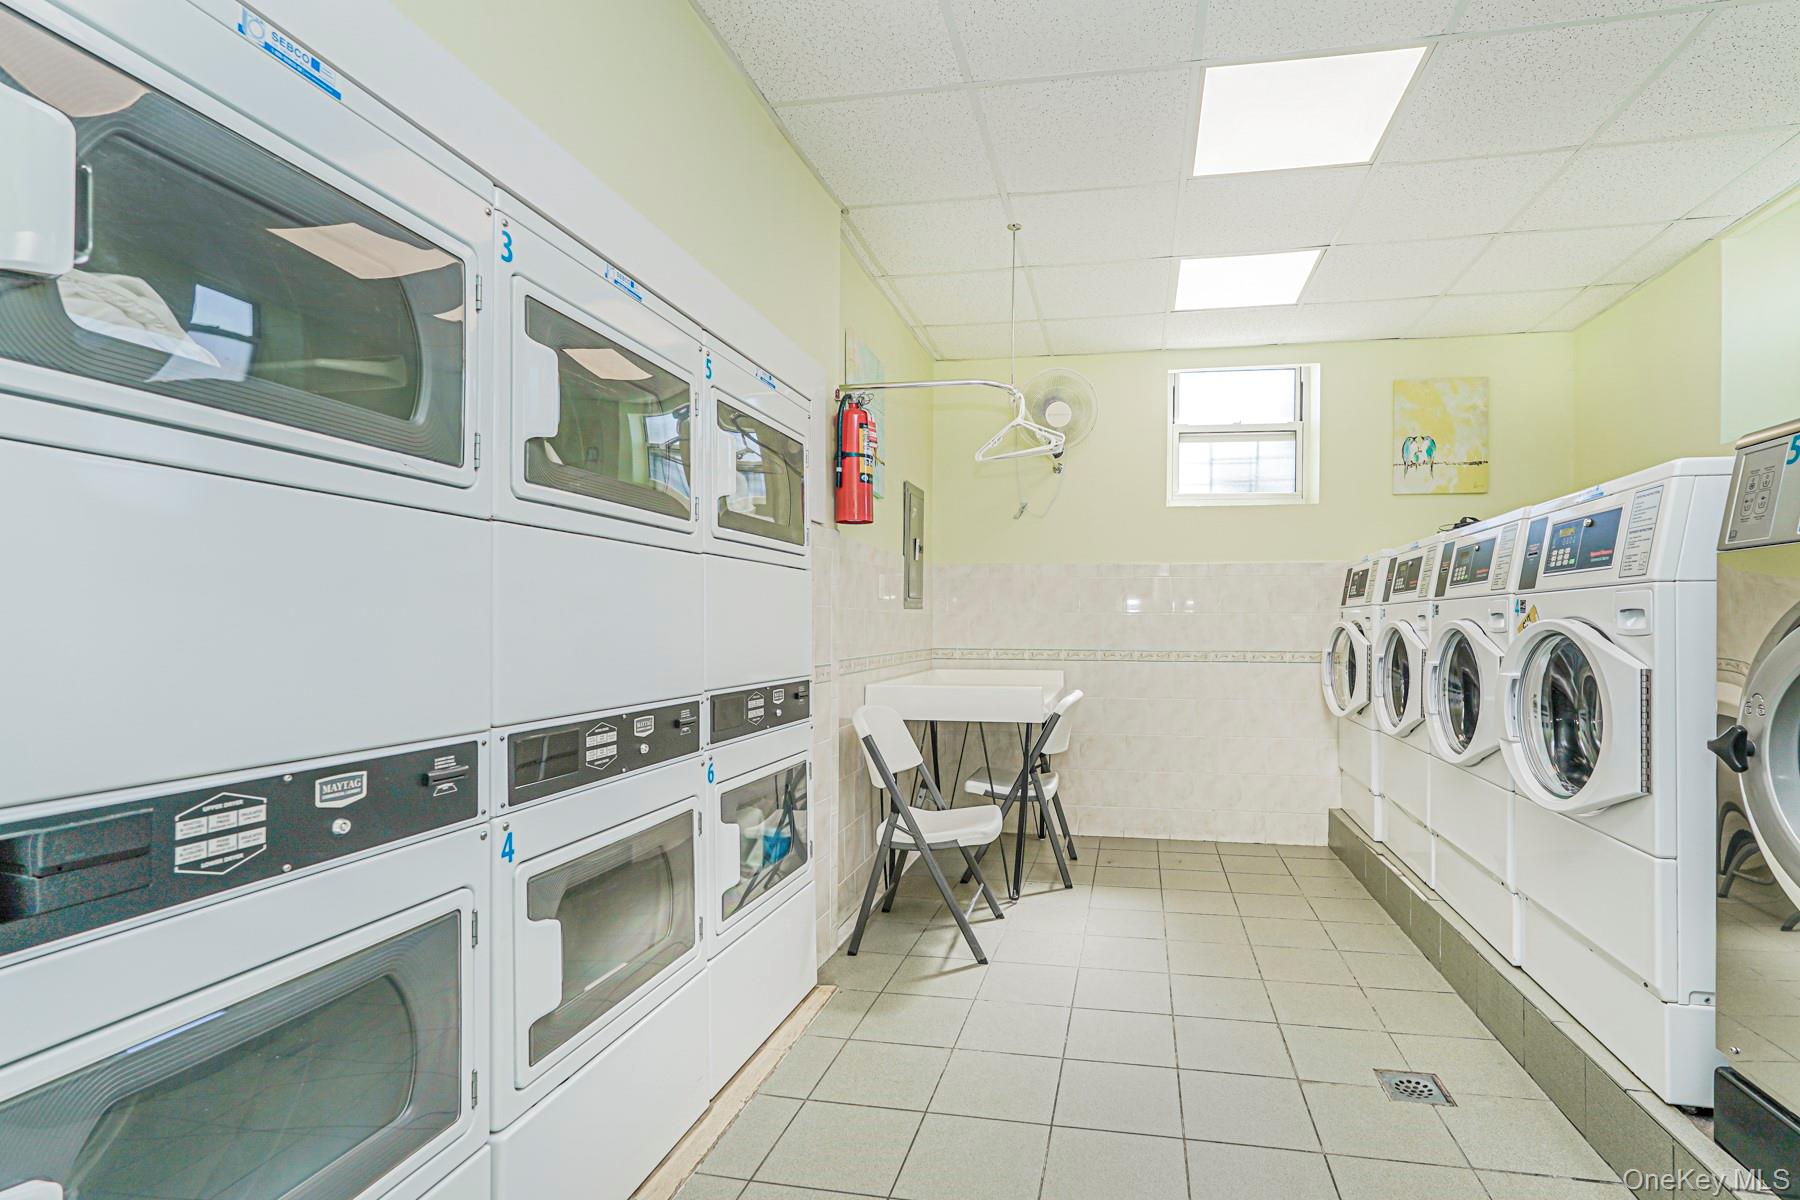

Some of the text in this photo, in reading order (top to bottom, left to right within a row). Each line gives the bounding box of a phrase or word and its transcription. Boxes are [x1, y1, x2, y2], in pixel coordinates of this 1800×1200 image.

[271, 31, 310, 64] SEBCO
[501, 230, 513, 263] 3
[706, 358, 712, 380] 5
[1786, 434, 1800, 465] 5
[322, 778, 361, 794] MAYTAG
[707, 762, 714, 784] 6
[501, 832, 514, 863] 4
